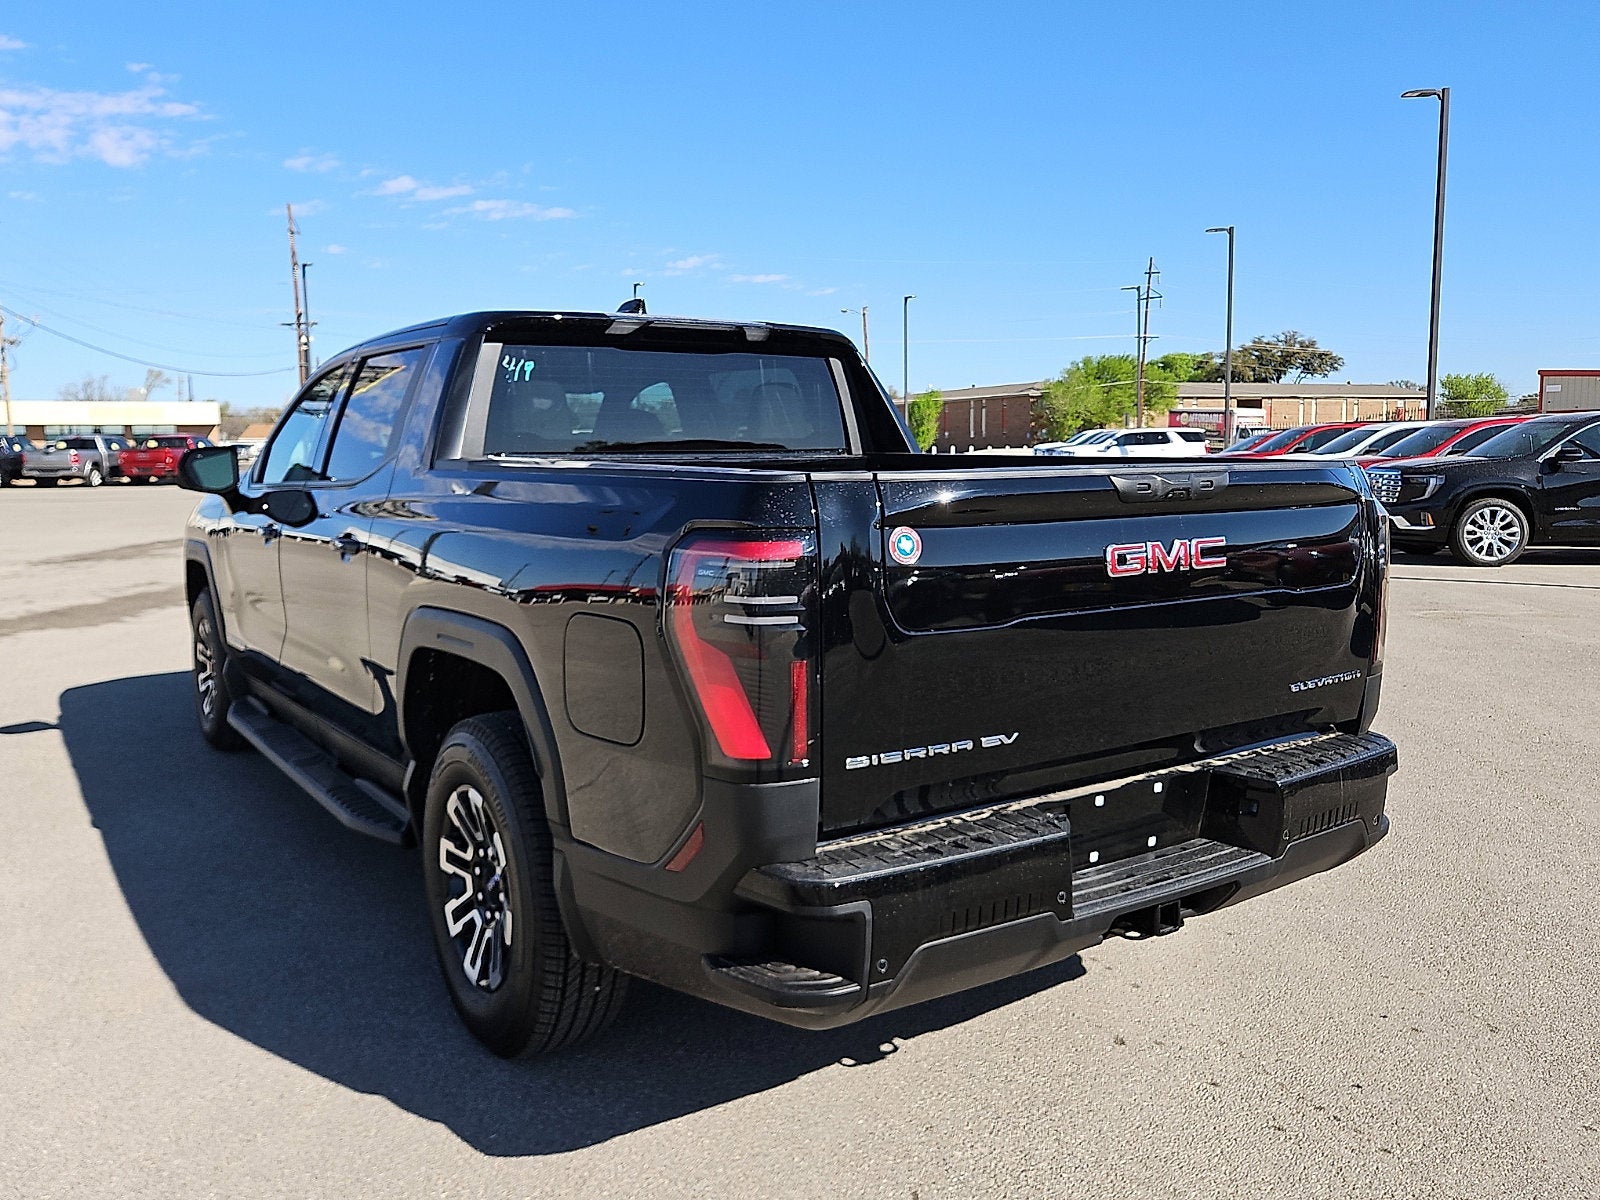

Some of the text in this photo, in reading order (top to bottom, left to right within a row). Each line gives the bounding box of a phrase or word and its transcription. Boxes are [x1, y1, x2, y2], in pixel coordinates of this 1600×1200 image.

[697, 568, 715, 577] GMC
[1106, 536, 1227, 578] GMC
[1289, 669, 1362, 693] ELEVATION
[845, 731, 1020, 770] SIERRA EV
